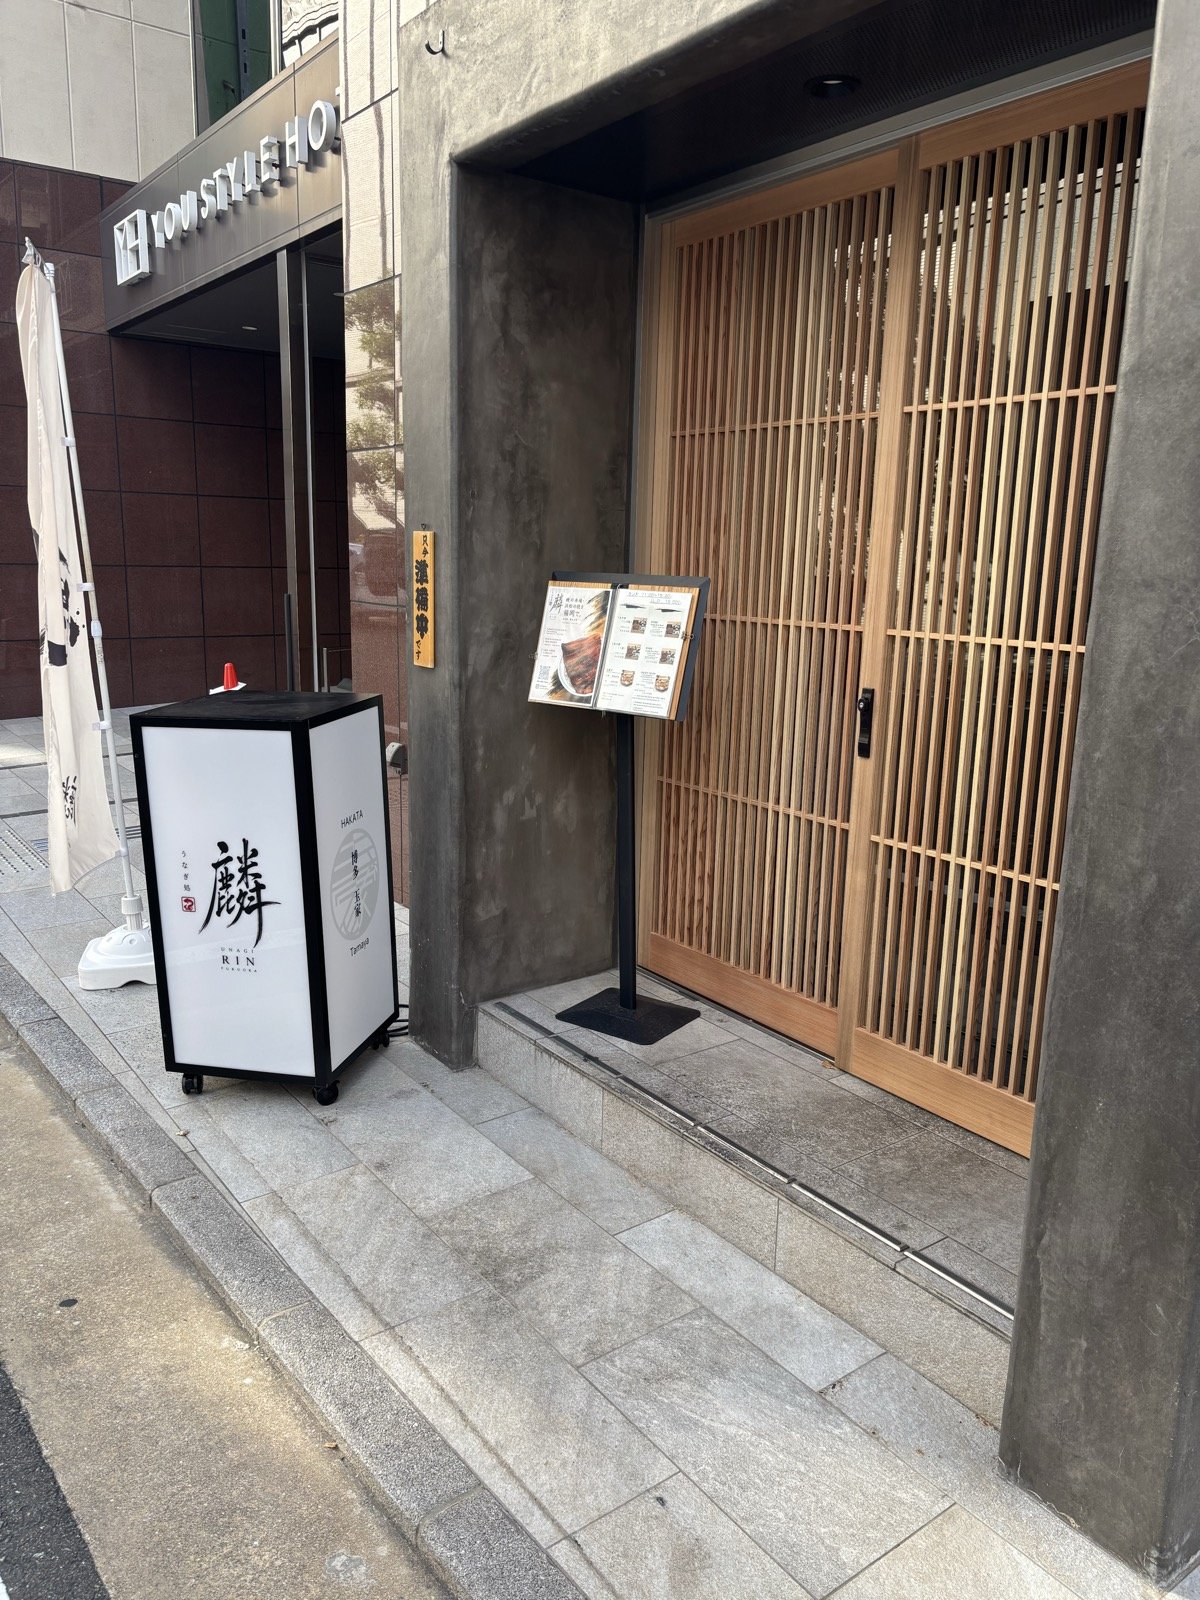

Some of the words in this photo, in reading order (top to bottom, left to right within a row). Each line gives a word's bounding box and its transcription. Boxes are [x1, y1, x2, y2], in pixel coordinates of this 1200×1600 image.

[200, 135, 280, 219] STYLE
[340, 809, 364, 829] HAKATA
[181, 849, 191, 892] うなぎ処
[350, 936, 370, 957] Tamaya
[222, 955, 256, 966] RIN
